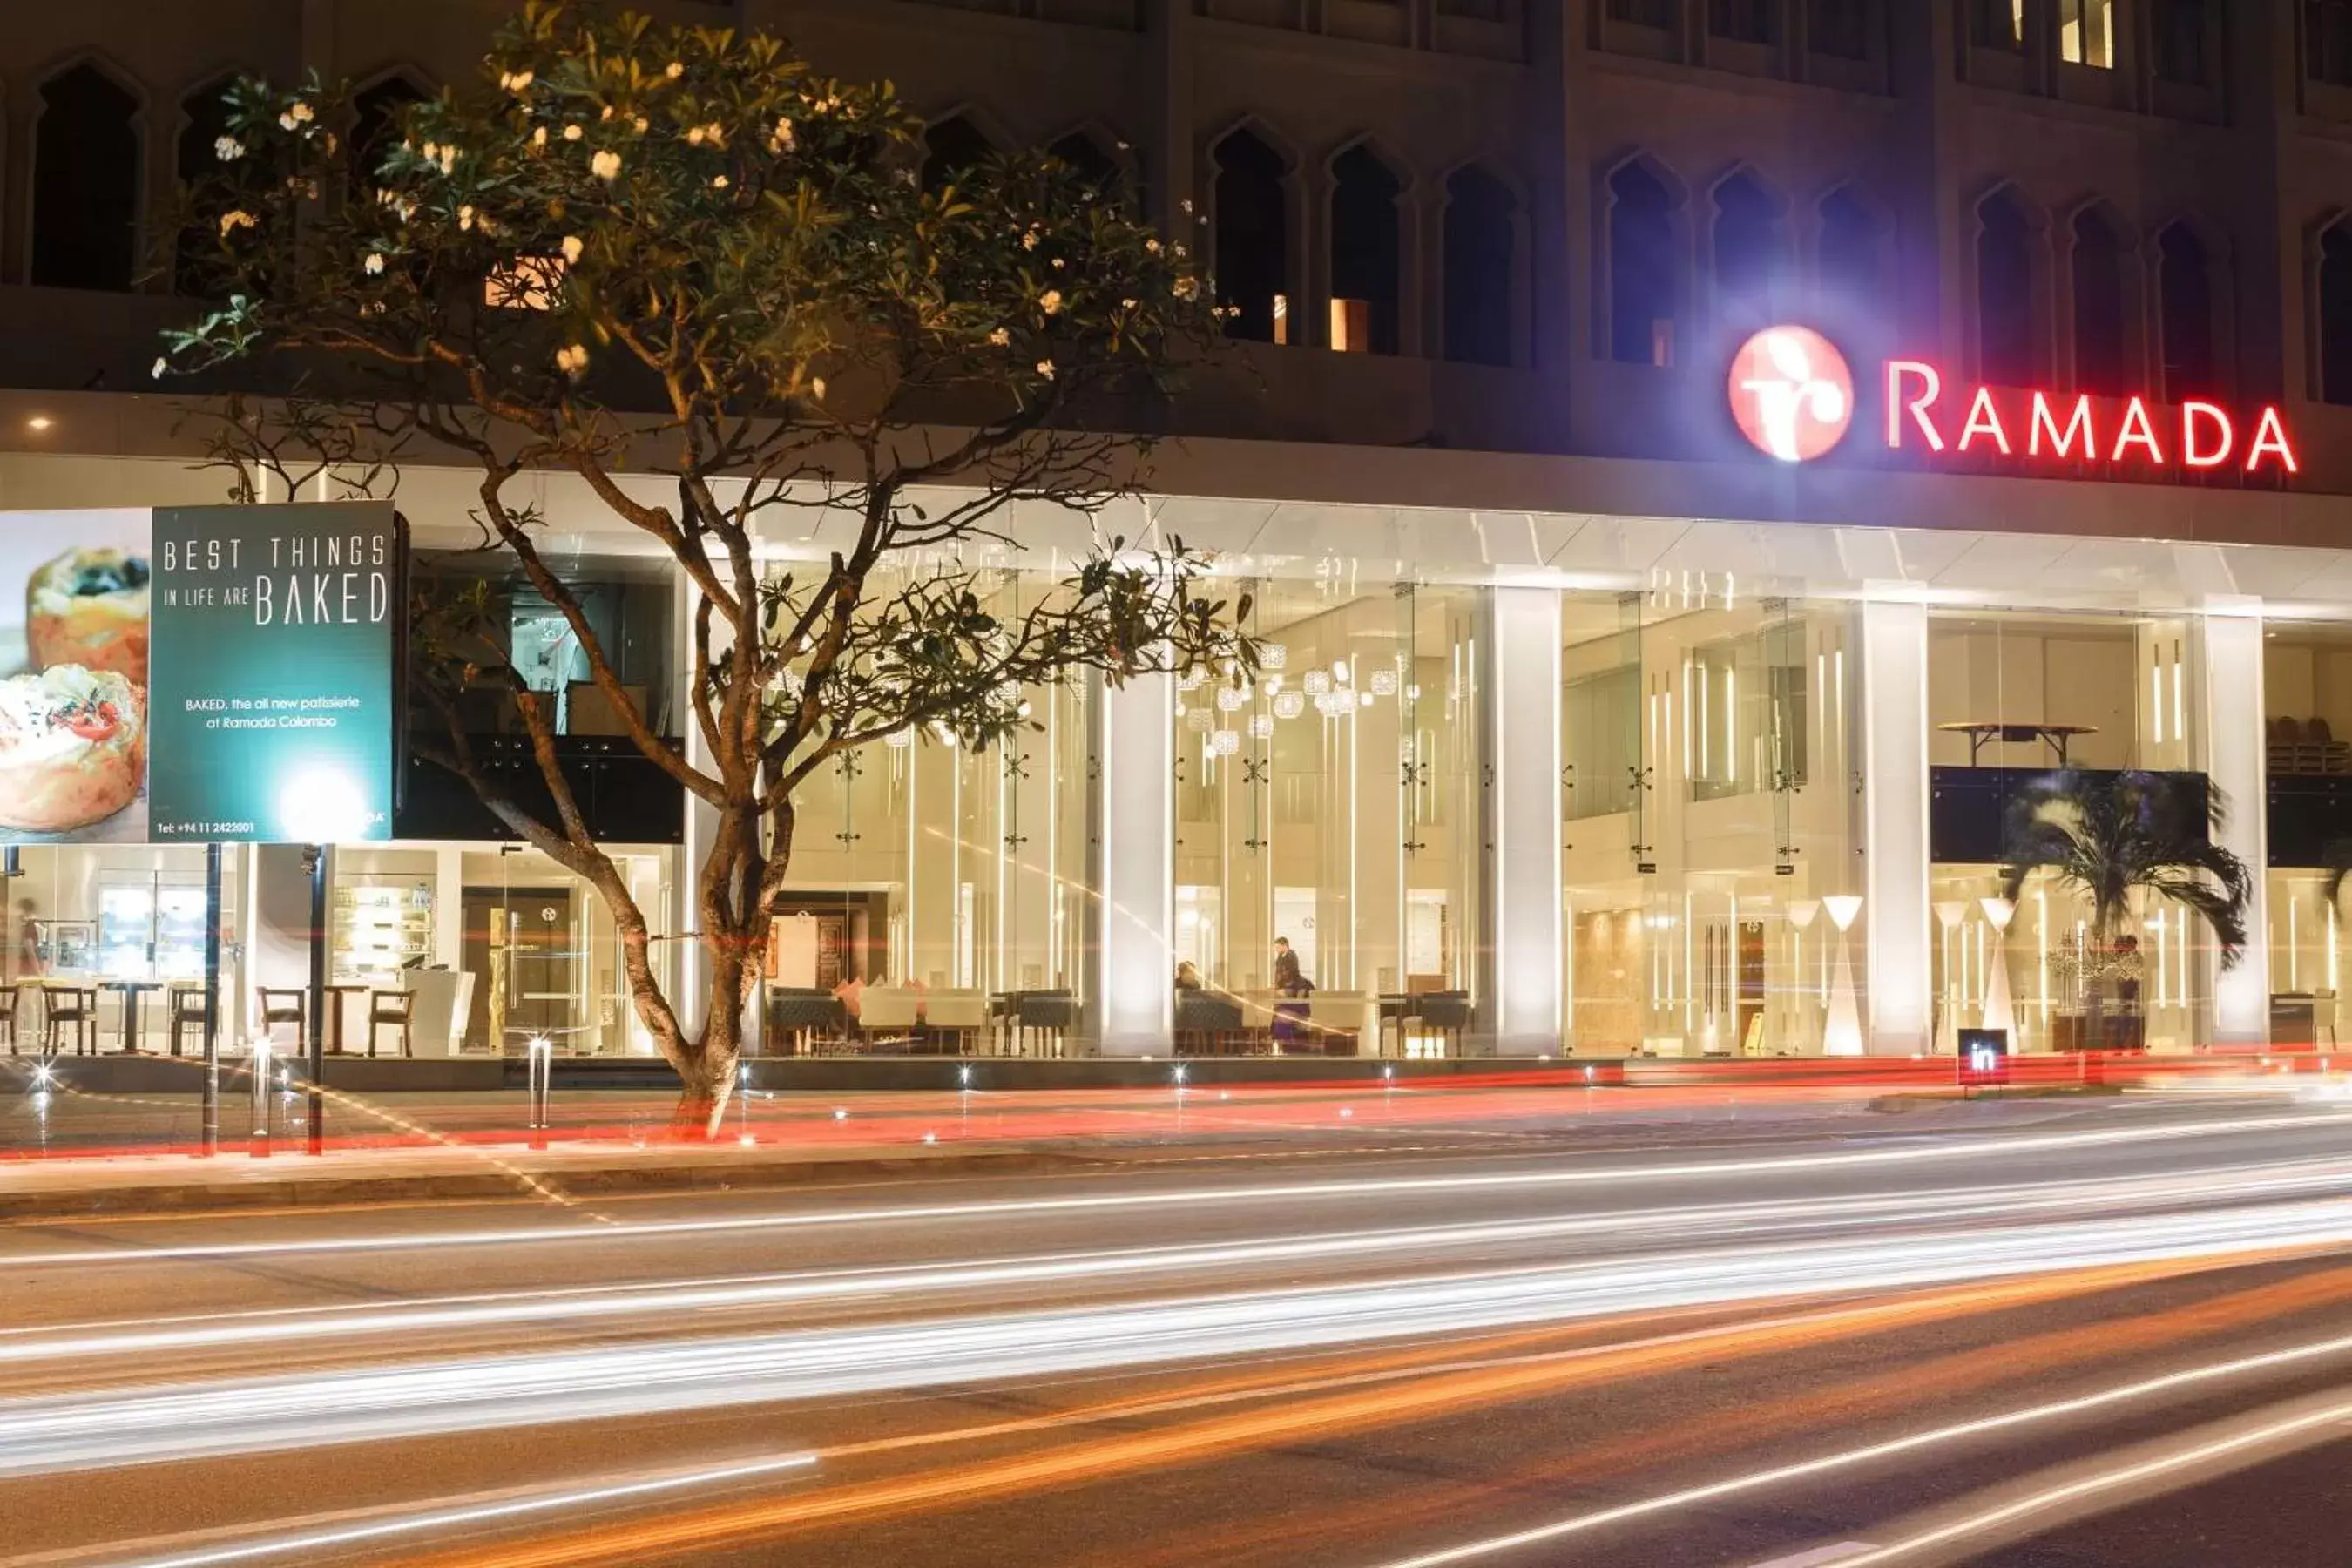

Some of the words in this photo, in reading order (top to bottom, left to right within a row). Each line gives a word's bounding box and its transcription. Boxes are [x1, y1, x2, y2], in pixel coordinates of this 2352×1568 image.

[1887, 360, 2299, 472] RAMADA
[163, 538, 241, 571] BEST
[270, 535, 384, 568] THINGS
[163, 588, 177, 606] IN
[184, 587, 214, 606] LIFE
[223, 586, 248, 605] ARE
[255, 571, 388, 625] BAKED
[186, 698, 228, 712] BAKED,
[231, 697, 252, 710] the
[254, 696, 269, 710] all
[271, 699, 297, 710] new
[206, 715, 220, 729] at
[222, 715, 277, 729] Ramada
[278, 713, 337, 728] Colombo
[158, 822, 175, 834] Tel:
[177, 822, 197, 834] +94
[199, 821, 210, 834] 11
